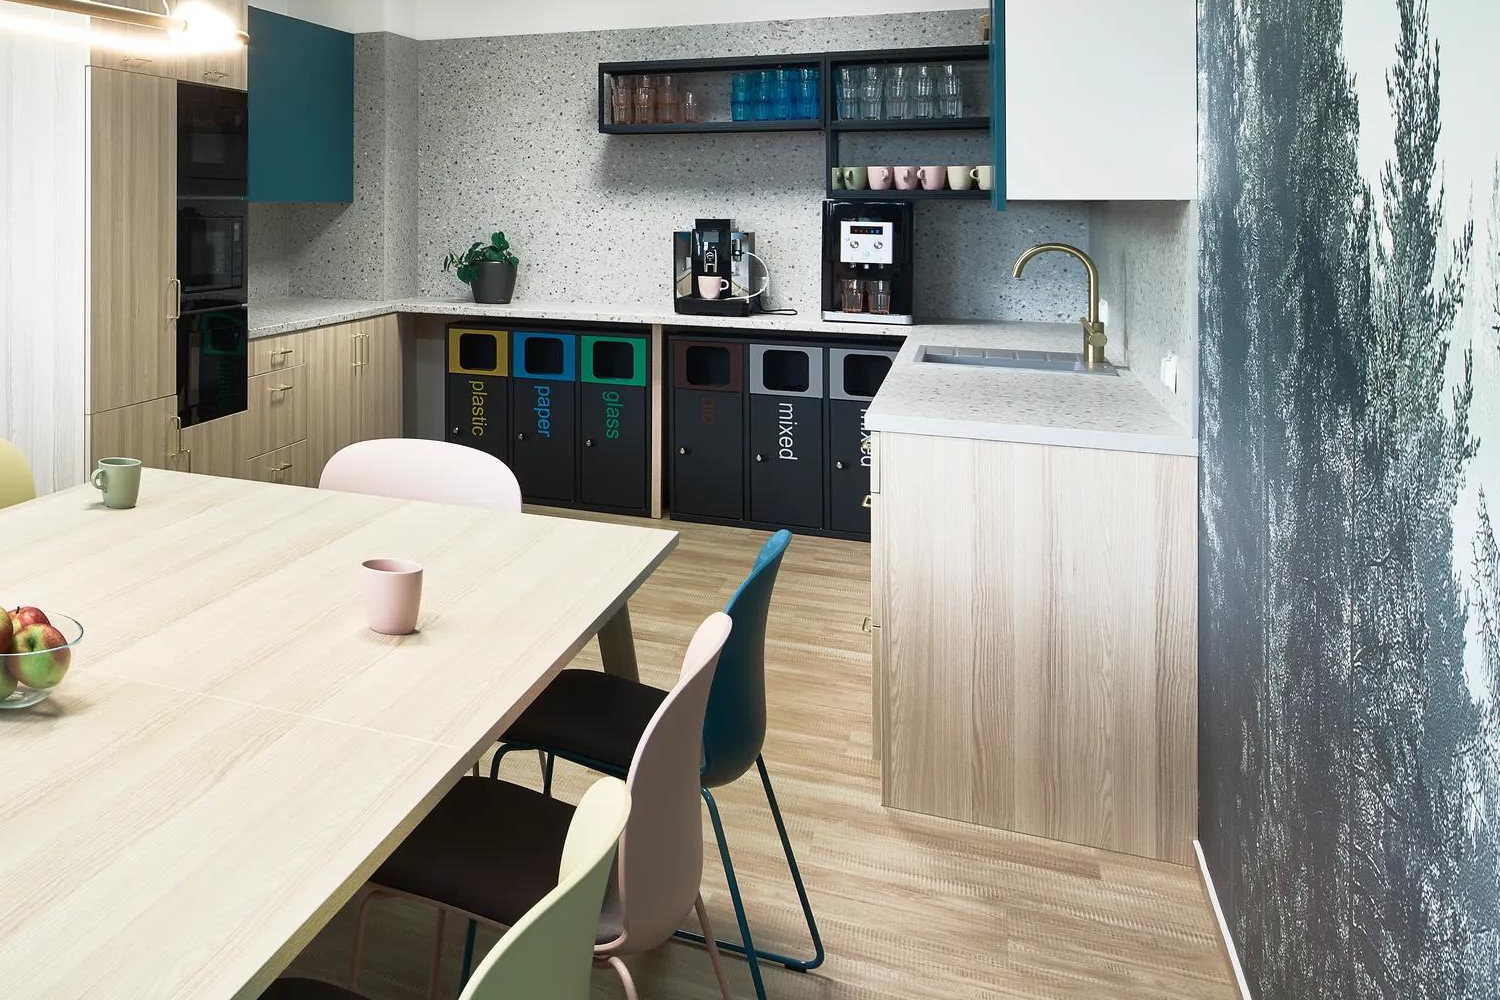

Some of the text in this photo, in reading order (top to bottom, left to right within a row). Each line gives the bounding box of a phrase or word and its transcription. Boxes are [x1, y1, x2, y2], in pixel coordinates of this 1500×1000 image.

[468, 380, 488, 437] plastic
[533, 385, 550, 438] paper
[602, 391, 624, 439] glass
[778, 402, 798, 460] mixed
